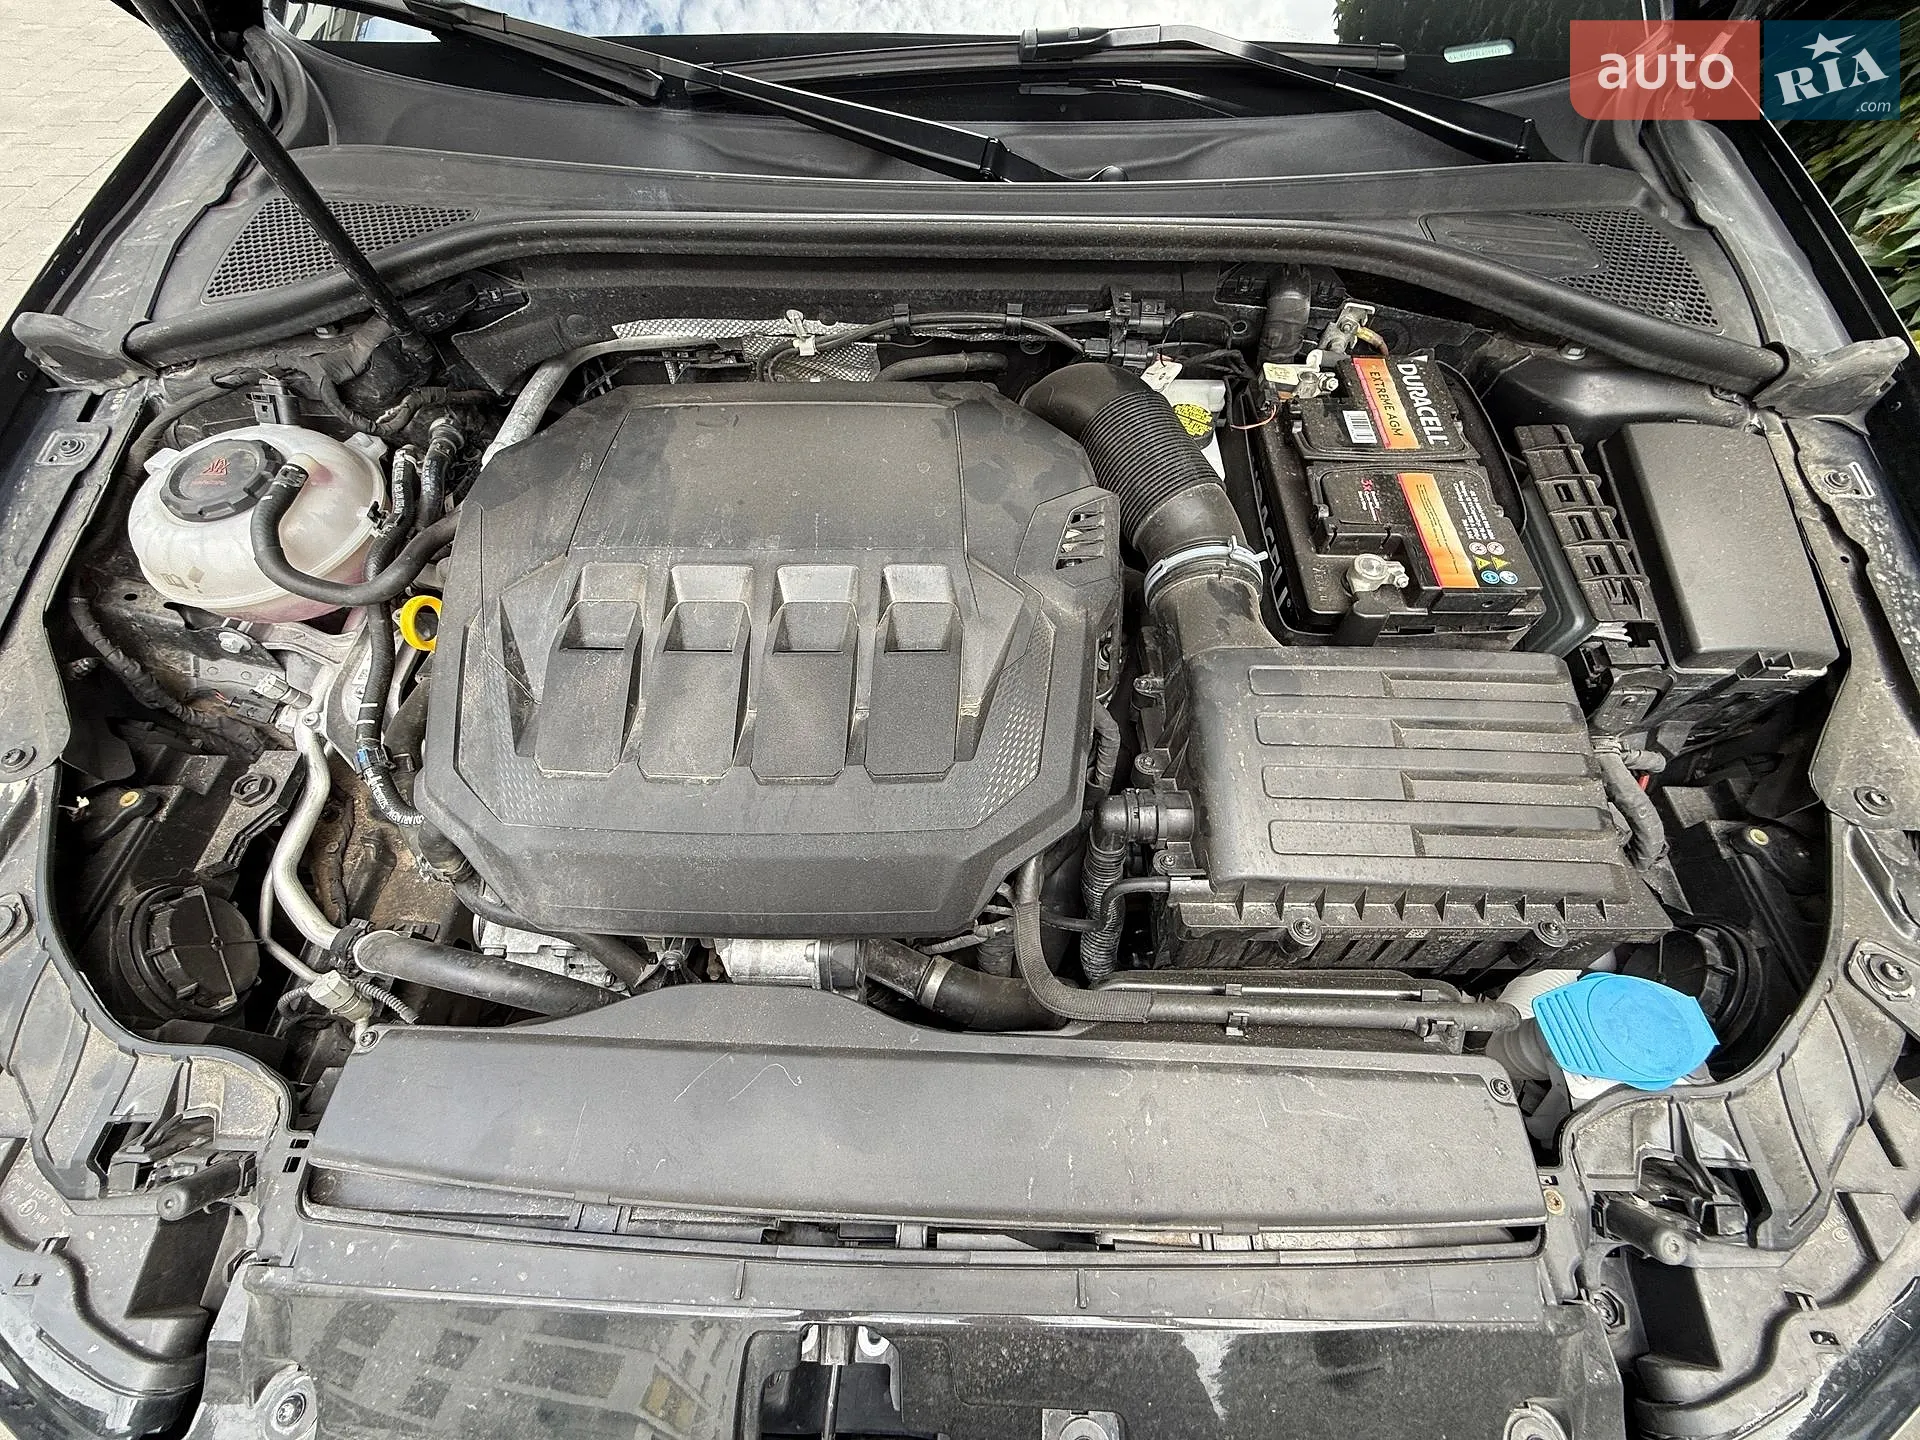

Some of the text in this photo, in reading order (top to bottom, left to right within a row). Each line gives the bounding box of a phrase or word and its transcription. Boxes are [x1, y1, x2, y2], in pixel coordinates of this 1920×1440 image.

[1369, 371, 1404, 437] EXTREME AGM
[1396, 363, 1448, 445] DURACELL
